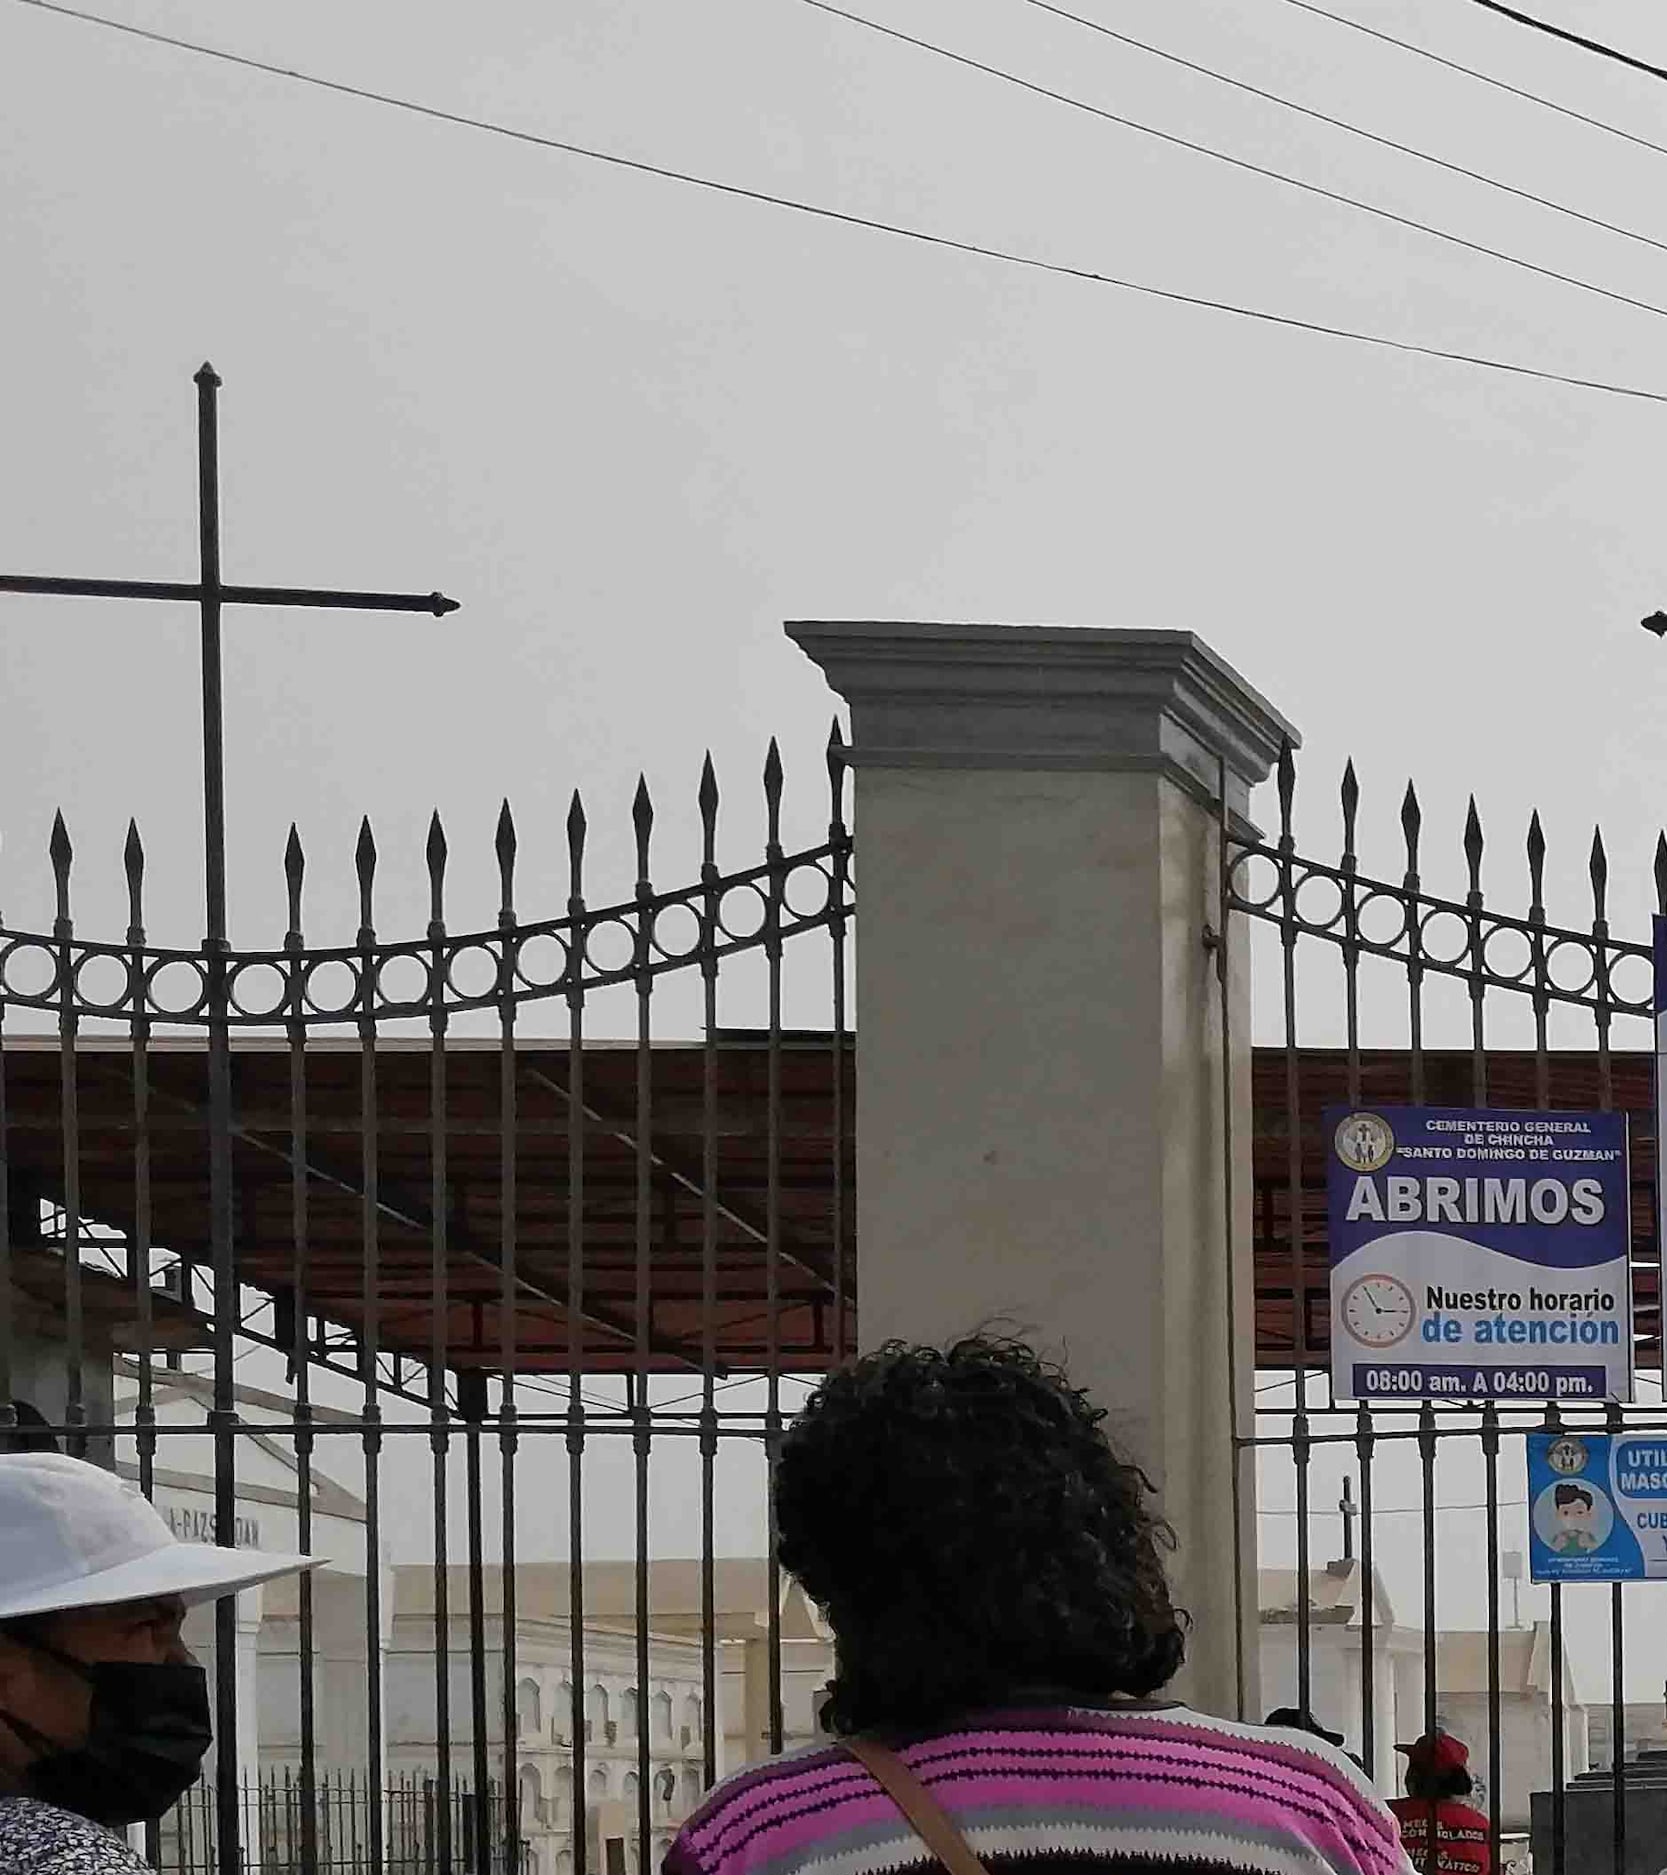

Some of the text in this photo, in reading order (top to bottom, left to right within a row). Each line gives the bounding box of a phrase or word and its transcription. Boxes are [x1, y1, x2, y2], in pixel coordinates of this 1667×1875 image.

[1426, 1120, 1591, 1133] CEMENTERIO GENERAL
[1464, 1134, 1554, 1145] DE CHINCHA
[1457, 1148, 1525, 1160] DOMINGO
[1529, 1149, 1549, 1160] DE
[1346, 1175, 1605, 1225] ABRIMOS
[1427, 1286, 1614, 1311] Nuestro horario
[1422, 1312, 1619, 1345] de atención
[1366, 1371, 1593, 1396] 08:00 am. A 04:00 pm.
